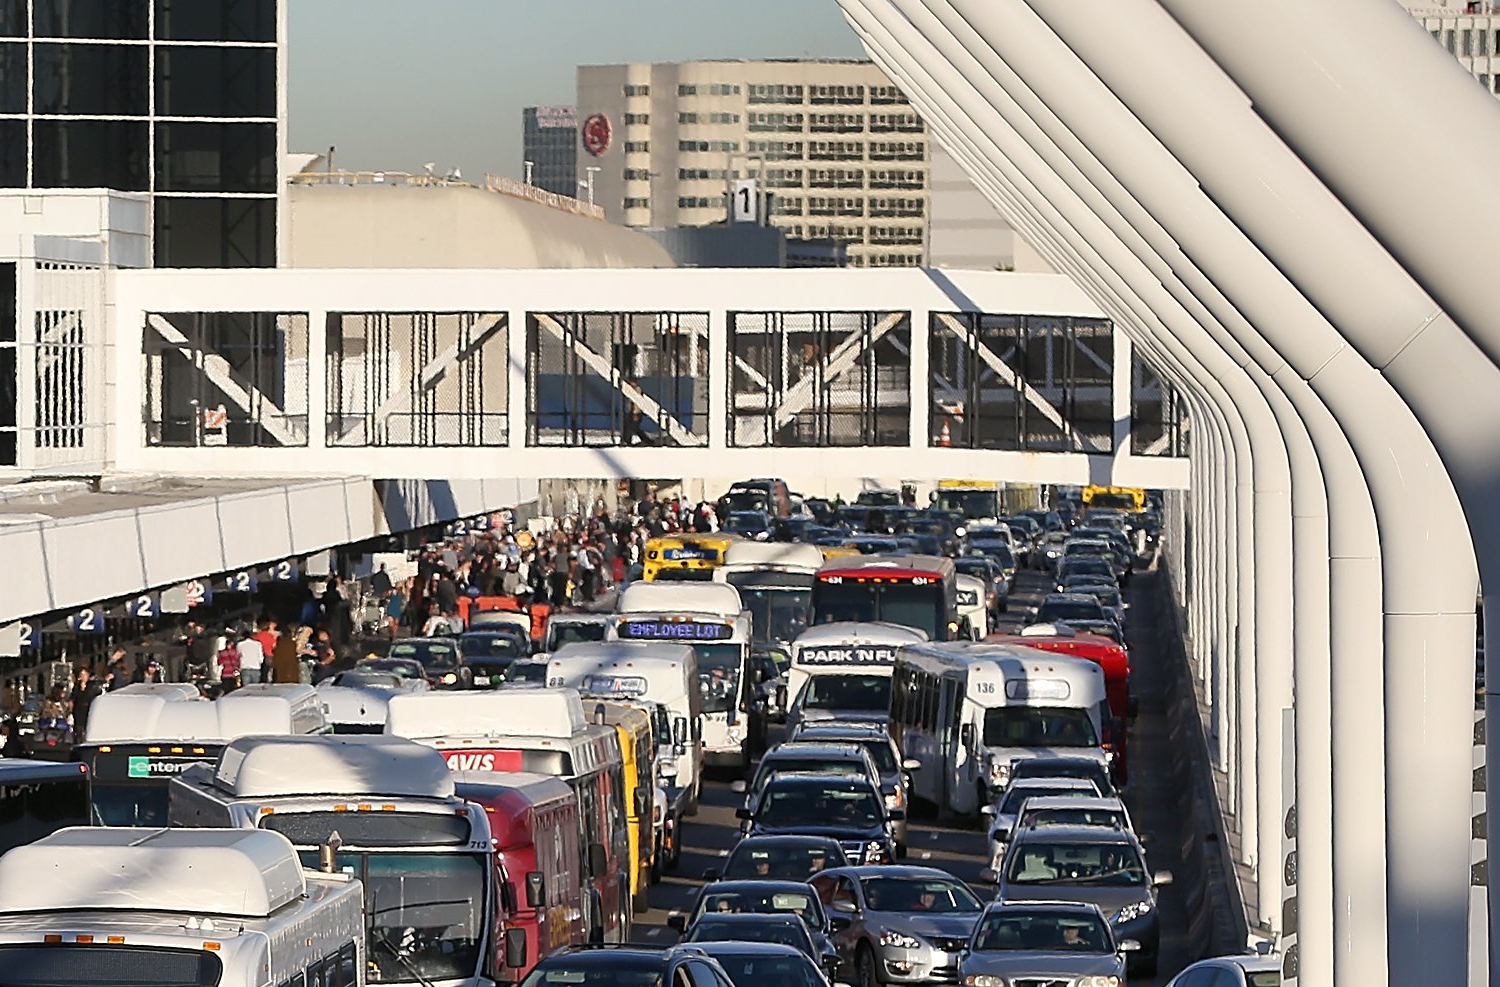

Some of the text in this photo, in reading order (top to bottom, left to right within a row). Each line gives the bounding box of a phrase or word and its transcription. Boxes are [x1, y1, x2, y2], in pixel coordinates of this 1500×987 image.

[738, 187, 749, 214] 1
[455, 520, 467, 535] 2
[278, 561, 292, 580] 2
[237, 571, 250, 592] 2
[137, 596, 153, 617] 2
[79, 608, 95, 631] 2
[19, 623, 33, 646] 2
[629, 623, 721, 637] EMPLOYEE LOT
[803, 650, 853, 662] PARK
[875, 650, 896, 662] FL
[976, 682, 995, 694] 136
[446, 753, 495, 771] AVIS
